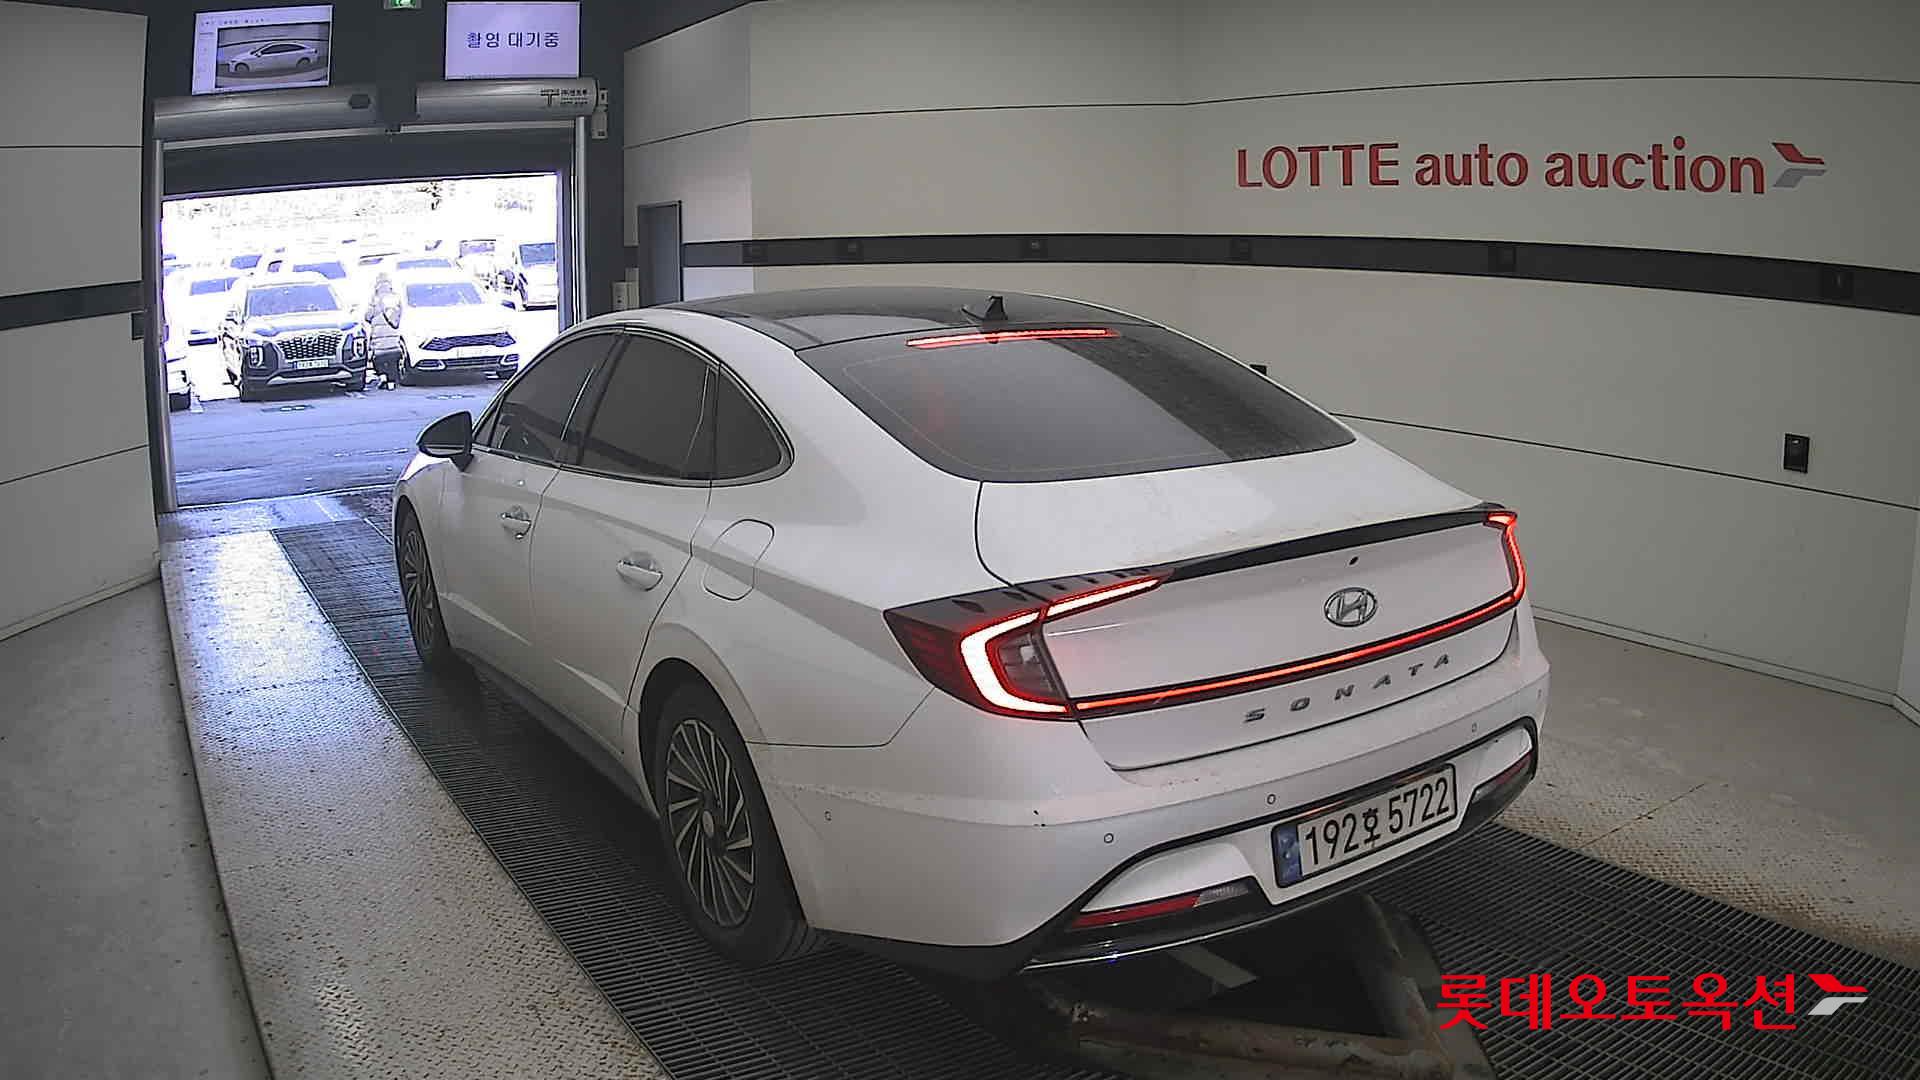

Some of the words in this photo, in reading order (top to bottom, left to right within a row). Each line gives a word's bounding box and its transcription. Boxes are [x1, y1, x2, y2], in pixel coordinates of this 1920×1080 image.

[467, 31, 500, 49] 촬영
[508, 31, 560, 48] 대기중
[1236, 143, 1399, 188] LOTTE
[1415, 143, 1529, 187] auto
[1544, 136, 1765, 194] auction
[1244, 653, 1449, 723] SONATA
